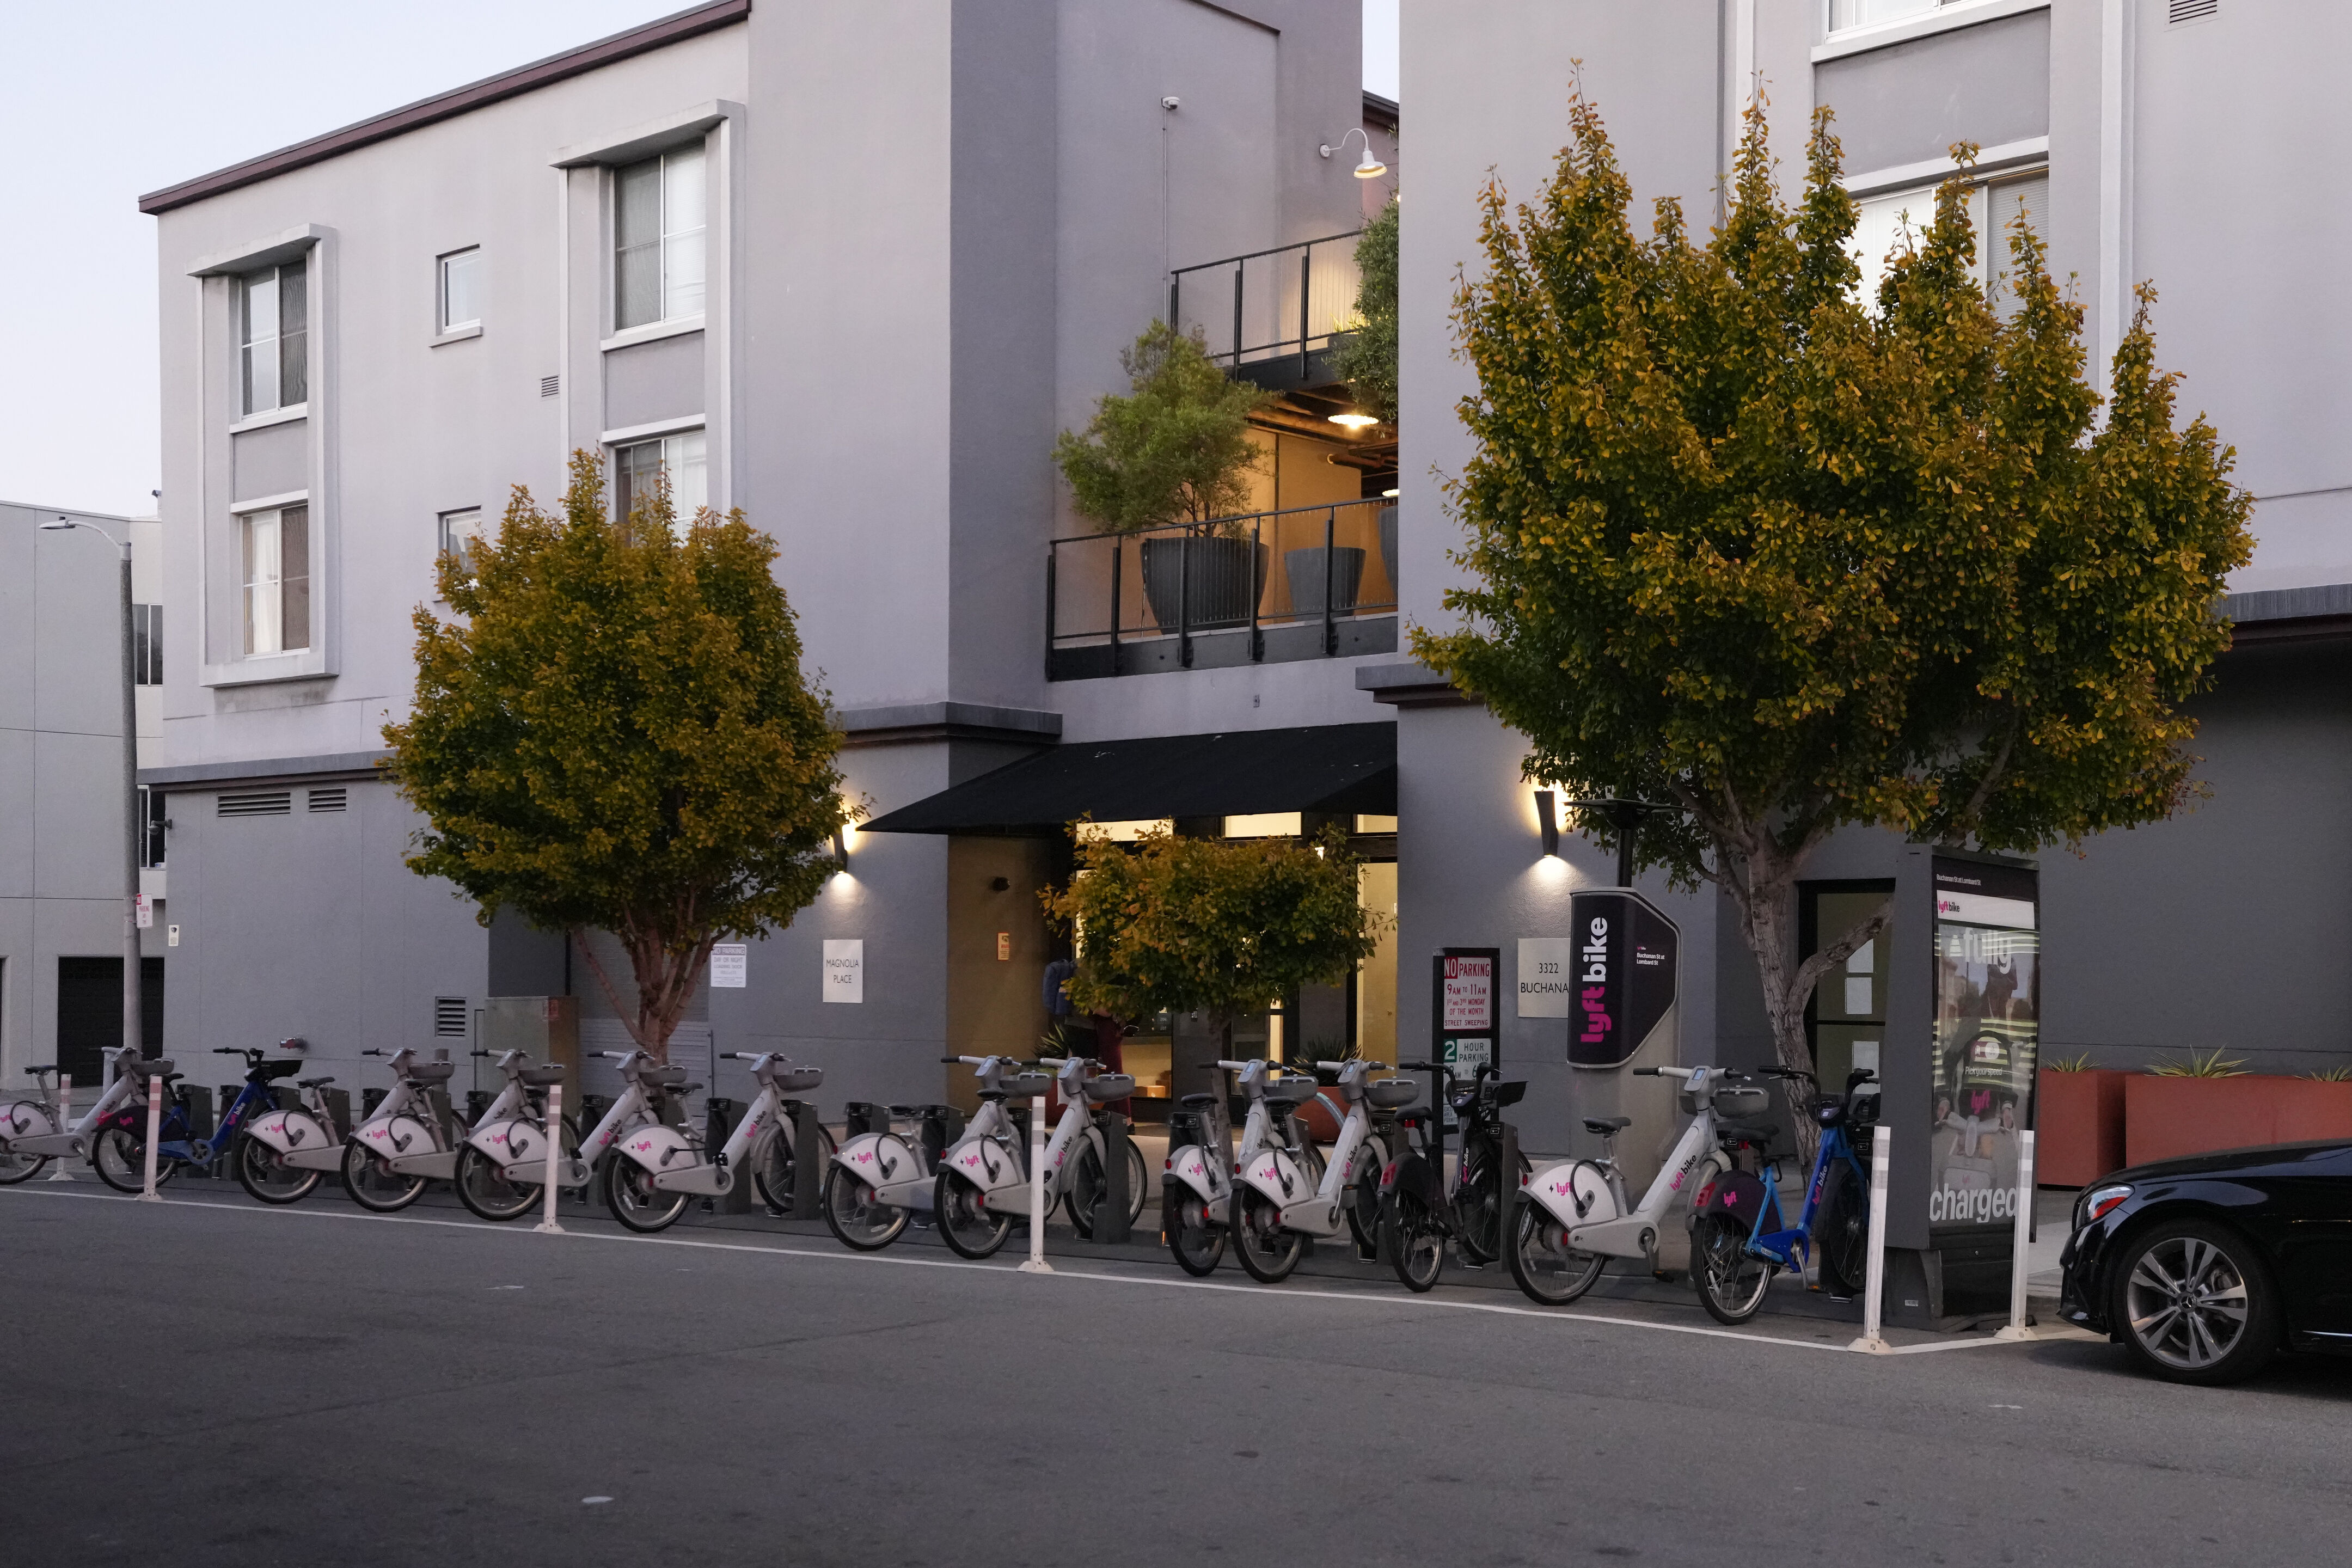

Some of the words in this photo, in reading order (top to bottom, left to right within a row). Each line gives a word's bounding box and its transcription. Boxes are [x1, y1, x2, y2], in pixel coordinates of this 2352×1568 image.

[1937, 874, 1953, 882] Buchanan
[1962, 877, 1977, 885] Lombard
[1963, 927, 2011, 975] fully
[826, 959, 859, 967] MAGNOLIA
[1444, 959, 1456, 977] NO
[1459, 963, 1490, 977] PARKING
[1539, 963, 1559, 973] 3322
[834, 975, 852, 983] PLACE
[1521, 983, 1569, 993] BUCHANA
[1444, 1041, 1455, 1060] 2
[1464, 1043, 1484, 1051] HOUR
[1459, 1054, 1489, 1062] PARKING
[1965, 1066, 1975, 1075] Pick
[1976, 1068, 1987, 1077] your
[1988, 1068, 2002, 1077] speed
[1971, 1089, 1990, 1114] lyft
[372, 1129, 387, 1139] lyft
[637, 1141, 651, 1152] lyft
[857, 1152, 873, 1163] lyft
[965, 1155, 979, 1167] lyft
[1191, 1163, 1203, 1176] lyft
[1264, 1167, 1277, 1180] lyft
[1556, 1182, 1573, 1196] lyft
[1724, 1191, 1737, 1207] lyft
